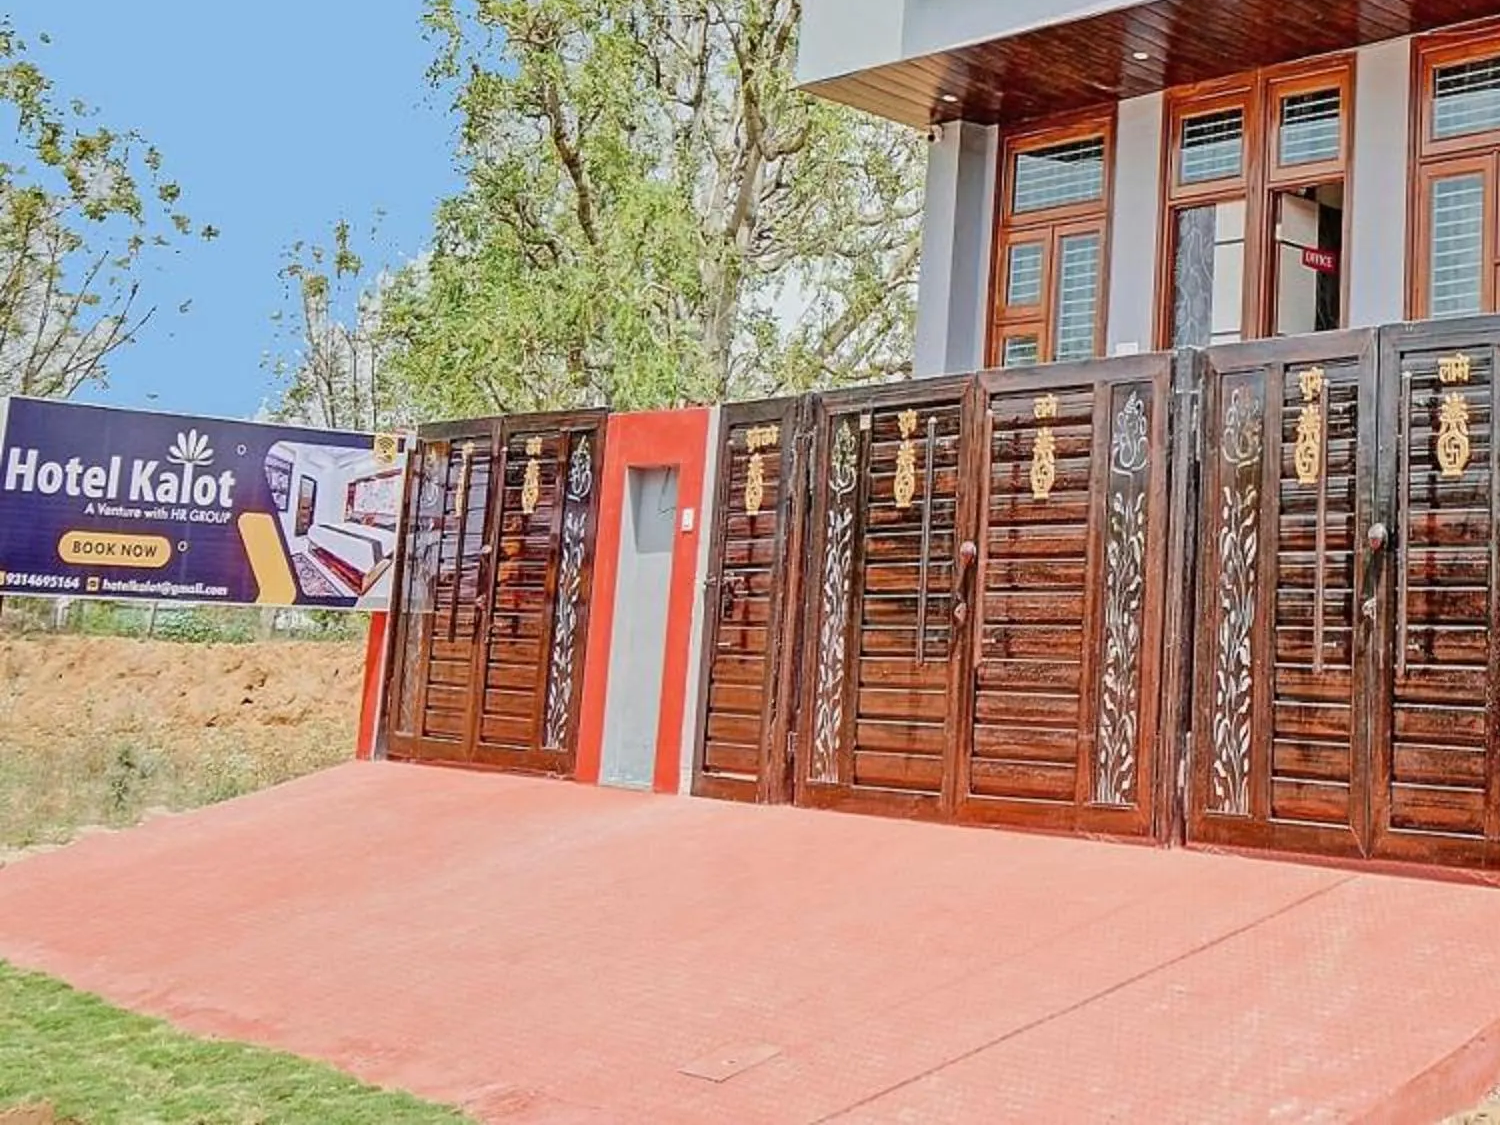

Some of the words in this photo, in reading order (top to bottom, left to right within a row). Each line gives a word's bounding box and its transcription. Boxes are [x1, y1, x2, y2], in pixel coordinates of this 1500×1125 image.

[1305, 250, 1333, 268] OFFICE
[4, 447, 121, 499] Hotel
[129, 458, 236, 507] Kalot
[84, 502, 95, 515] A
[98, 503, 141, 518] Venture
[143, 506, 168, 520] with
[170, 508, 187, 521] HR
[189, 509, 232, 524] GROUP
[71, 540, 116, 556] BOOK
[121, 542, 157, 557] NOW
